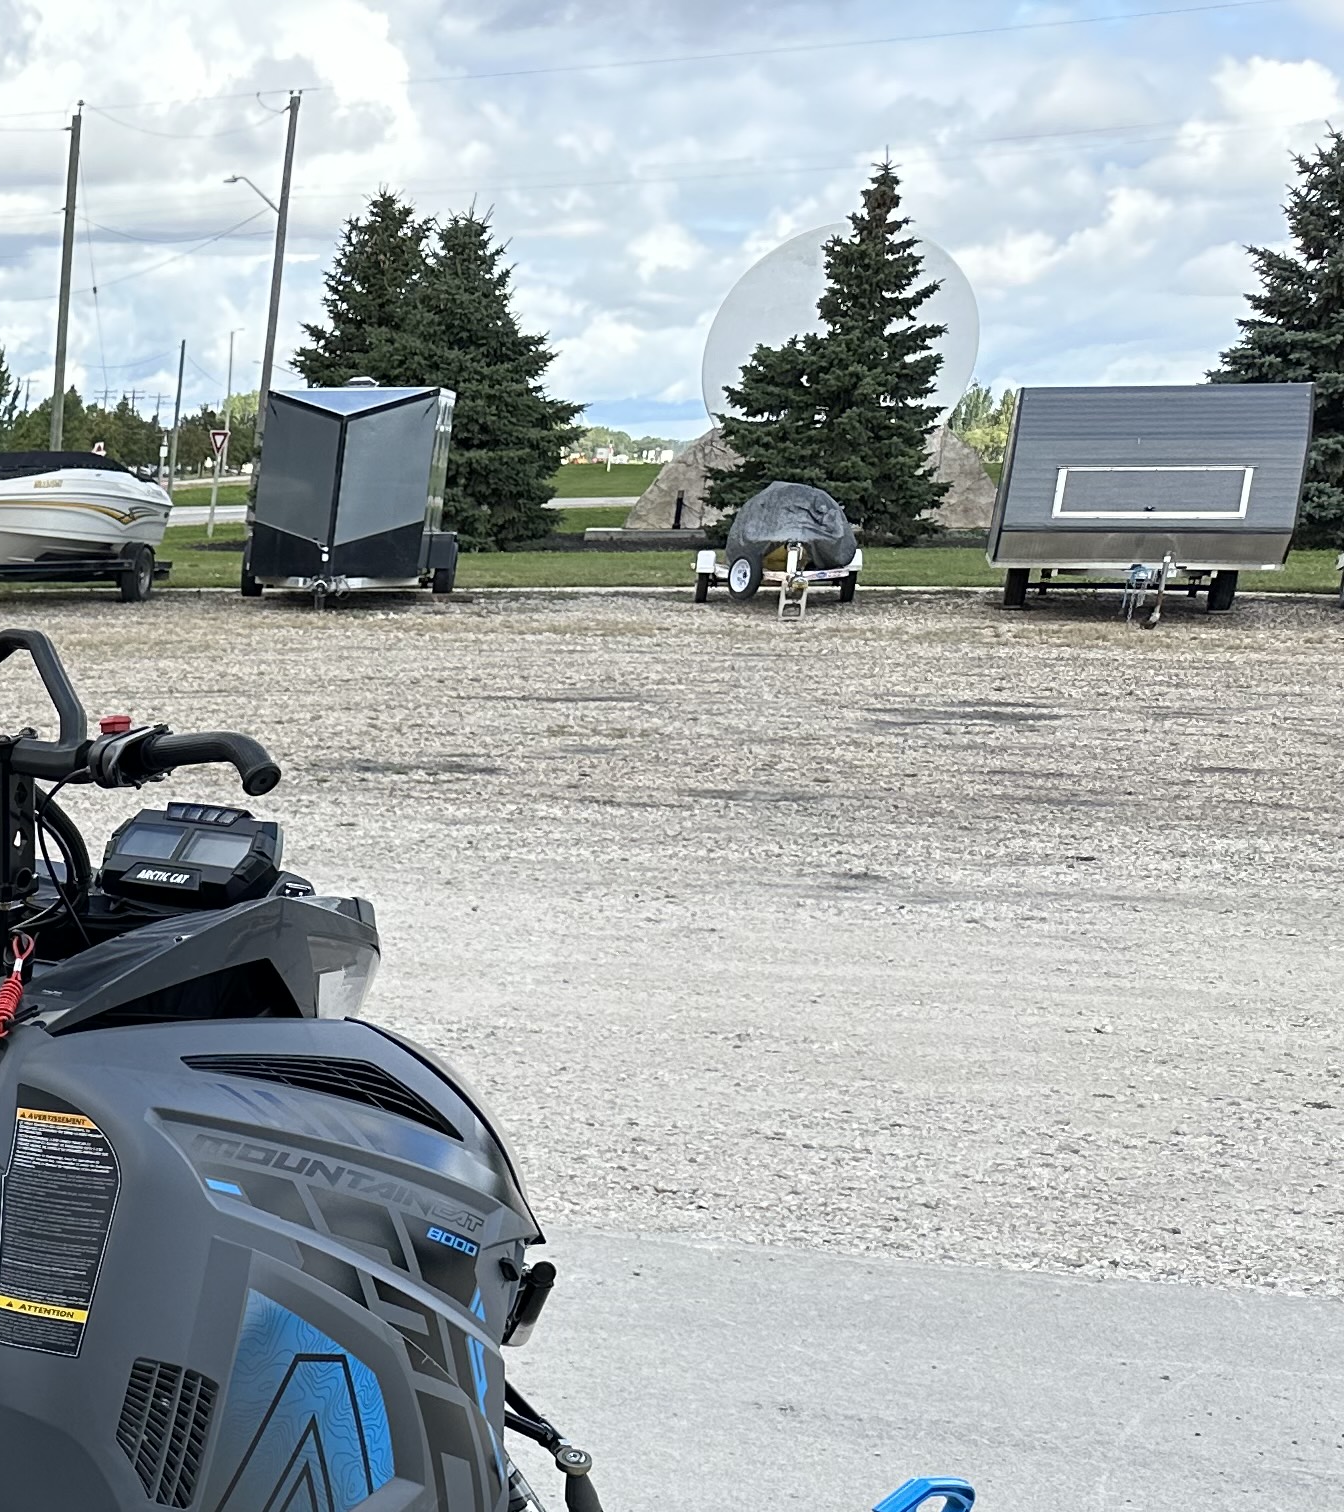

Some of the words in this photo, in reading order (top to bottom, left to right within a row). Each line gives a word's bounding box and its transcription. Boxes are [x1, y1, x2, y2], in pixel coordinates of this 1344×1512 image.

[136, 868, 171, 883] ARCTIC
[169, 873, 191, 885] CAT
[426, 1226, 479, 1257] 8000
[18, 1303, 75, 1319] ATTENTION
